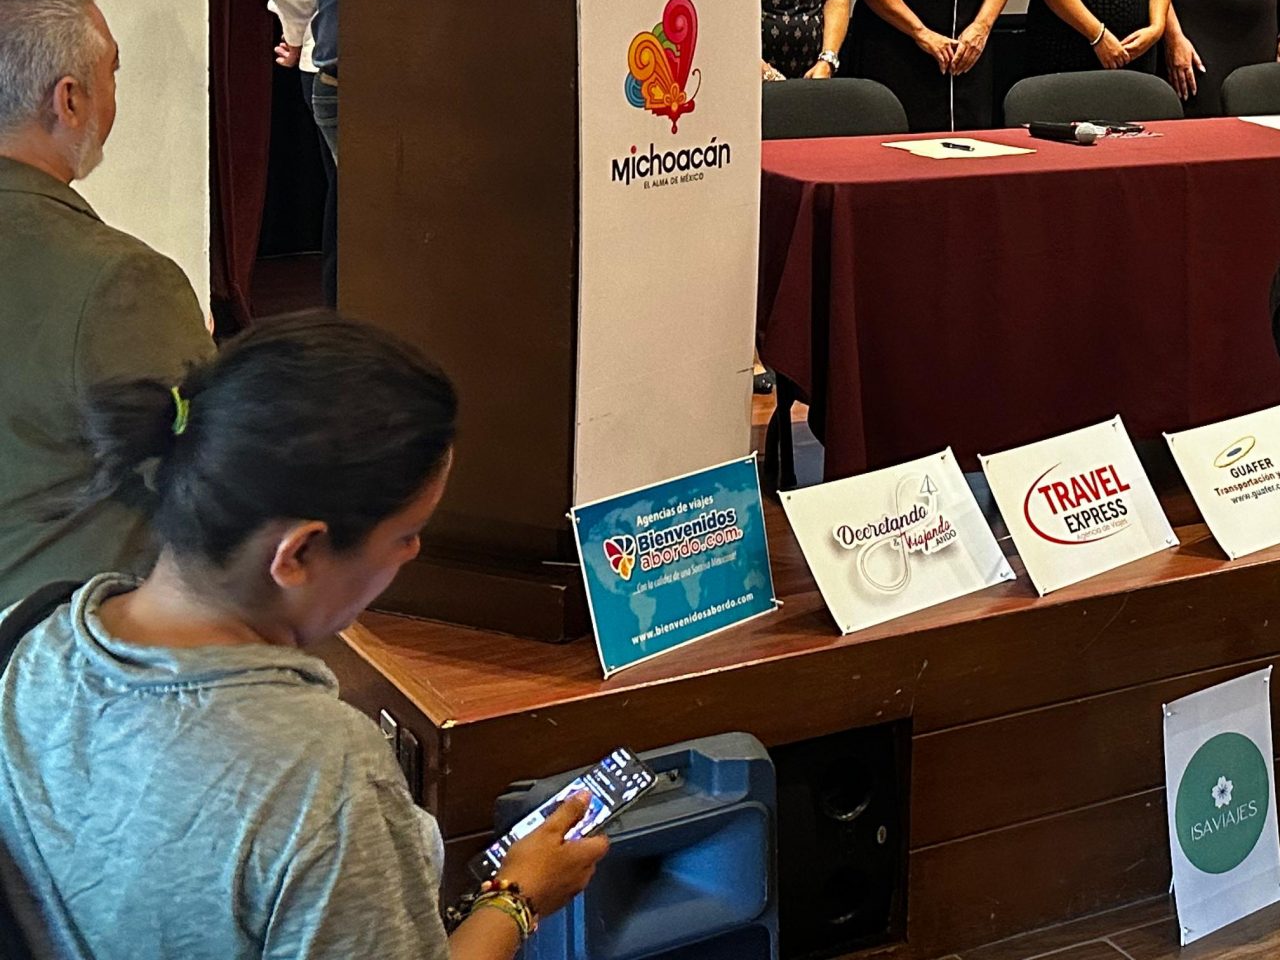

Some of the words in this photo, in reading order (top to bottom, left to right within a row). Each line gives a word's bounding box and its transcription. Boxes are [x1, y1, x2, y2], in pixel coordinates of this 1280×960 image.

[612, 137, 730, 186] Michoacán
[644, 181, 650, 189] EL
[652, 178, 668, 187] ALMA
[671, 176, 678, 185] DE
[680, 172, 704, 183] MÉXICO
[1214, 471, 1275, 496] Transportación
[1230, 457, 1274, 478] GUAFER
[1037, 464, 1131, 515] TRAVEL
[636, 508, 676, 527] Agencias
[677, 502, 687, 514] de
[689, 495, 714, 510] viajes
[837, 504, 928, 545] Decretando
[1063, 498, 1128, 534] EXPRESS
[637, 509, 736, 554] Bienvenidos
[935, 529, 957, 545] ANDO
[631, 592, 754, 645] www.bienvenidosabordo.com
[1190, 800, 1258, 841] ISAVIAJES
